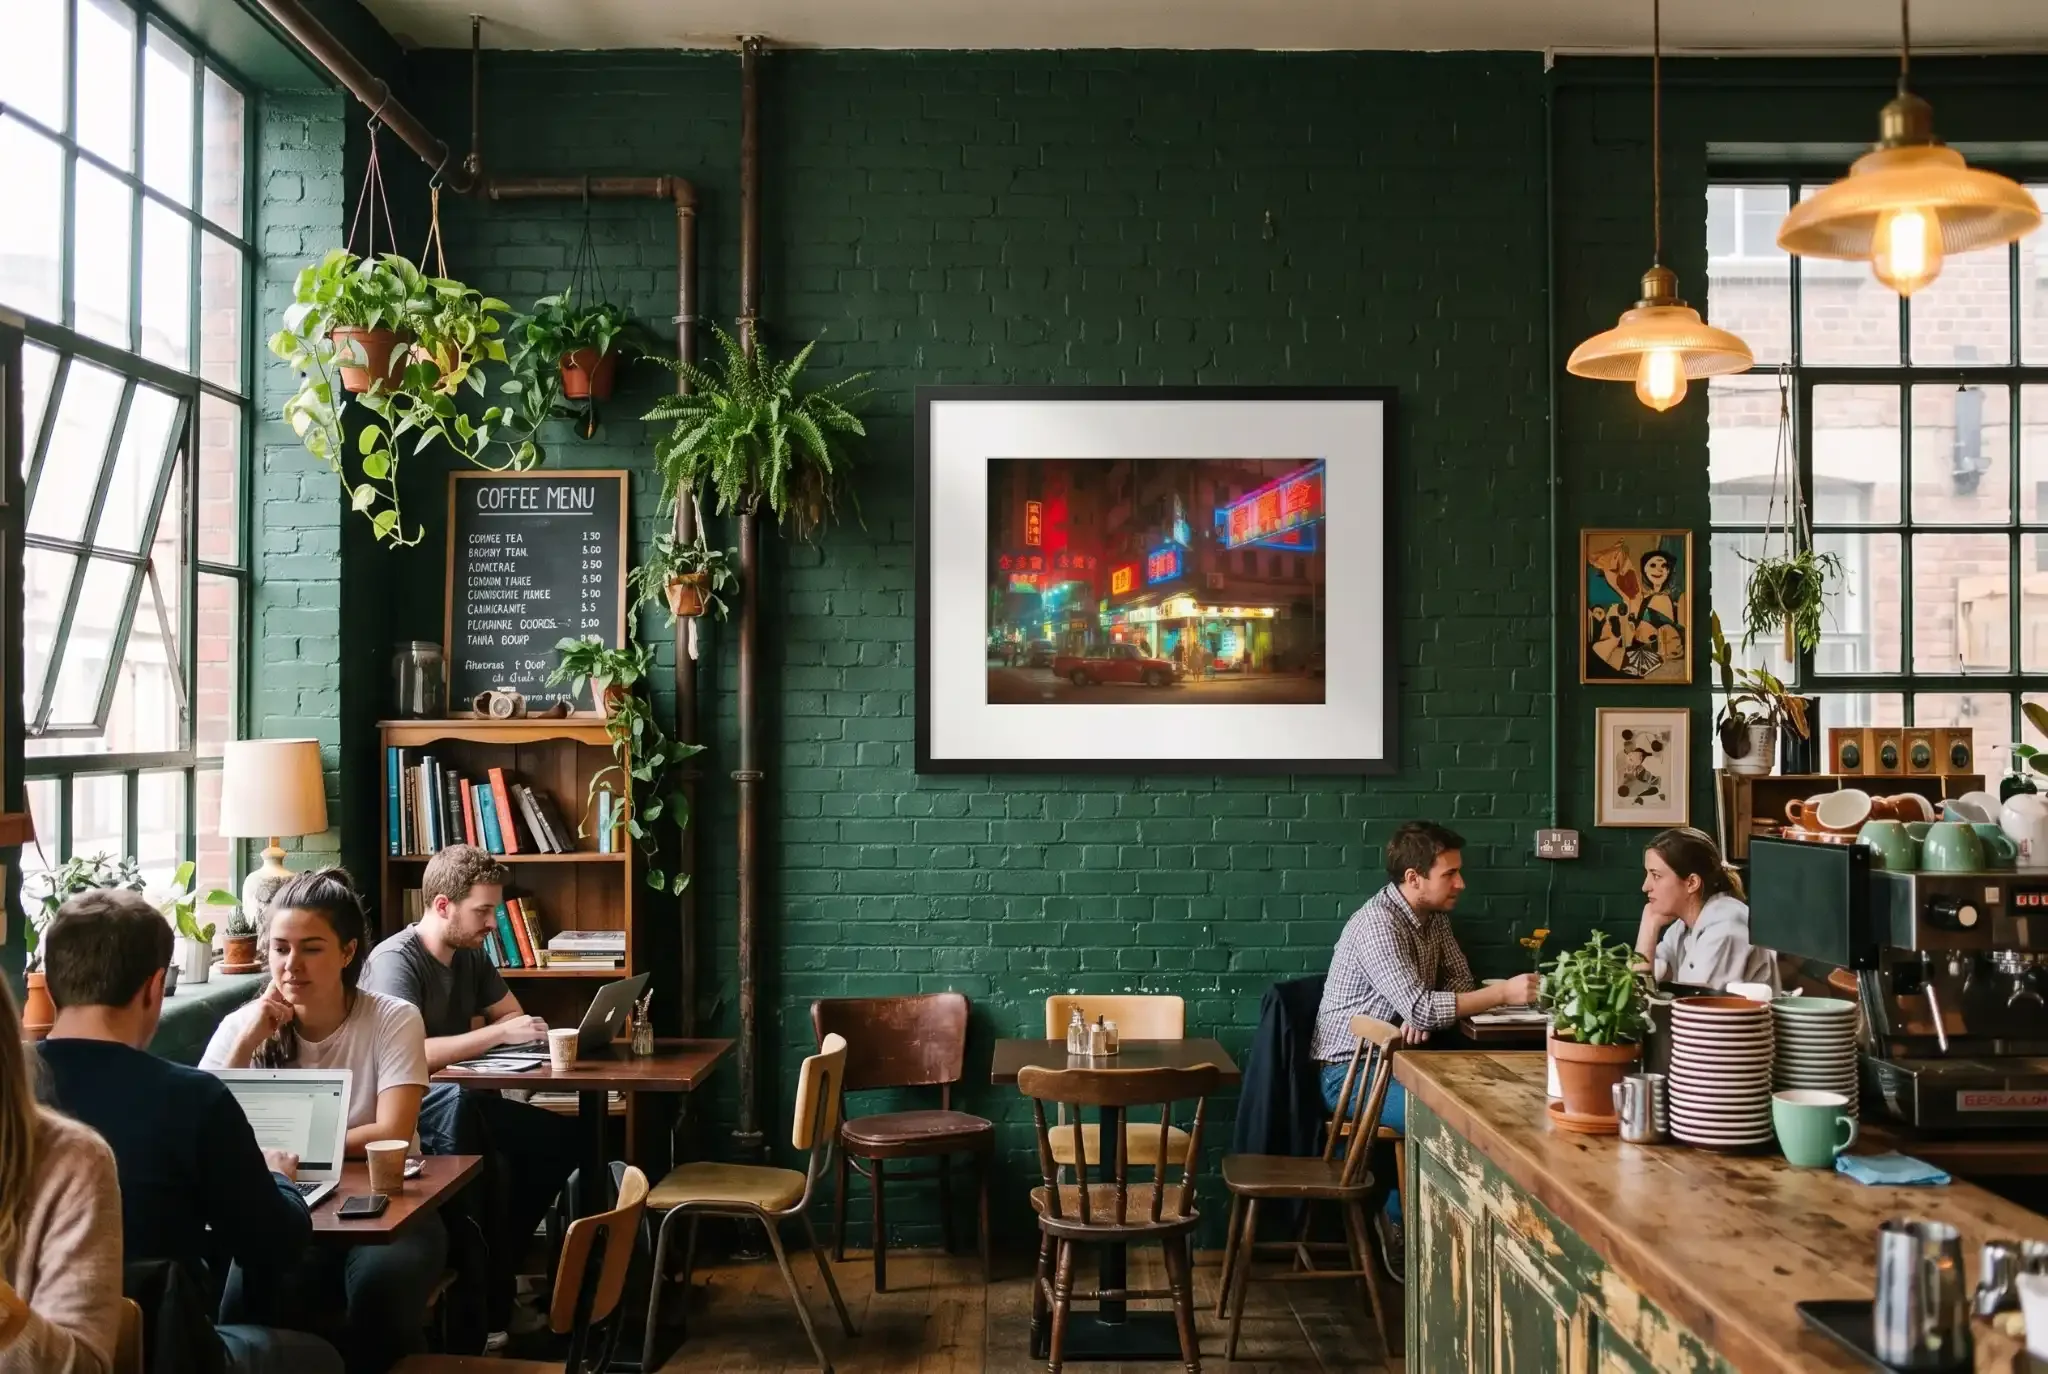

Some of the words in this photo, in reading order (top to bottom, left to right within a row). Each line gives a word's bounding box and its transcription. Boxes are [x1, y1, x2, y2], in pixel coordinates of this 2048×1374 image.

[477, 487, 540, 509] COFFEE
[547, 487, 594, 509] MENU
[506, 534, 523, 543] TEA
